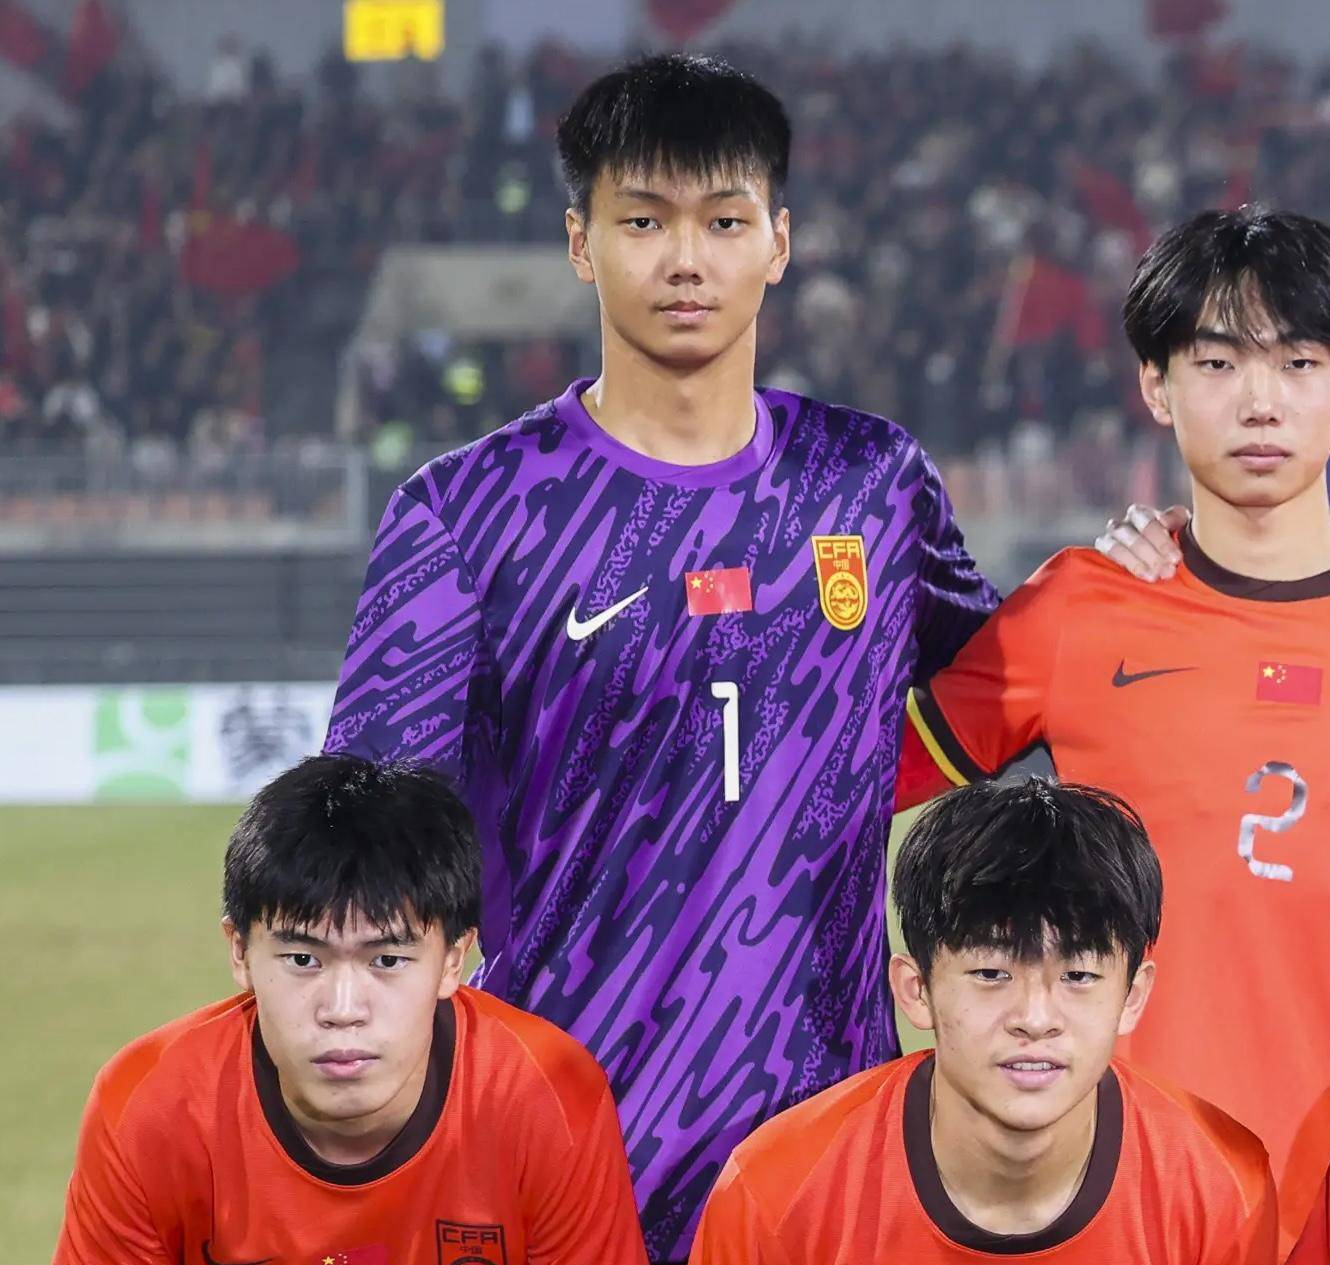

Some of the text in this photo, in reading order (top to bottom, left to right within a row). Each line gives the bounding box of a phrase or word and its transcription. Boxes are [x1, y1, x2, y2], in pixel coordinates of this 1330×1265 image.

[818, 542, 860, 559] CFA
[711, 682, 740, 801] 1
[1238, 761, 1308, 881] 2
[442, 1228, 497, 1244] CFA
